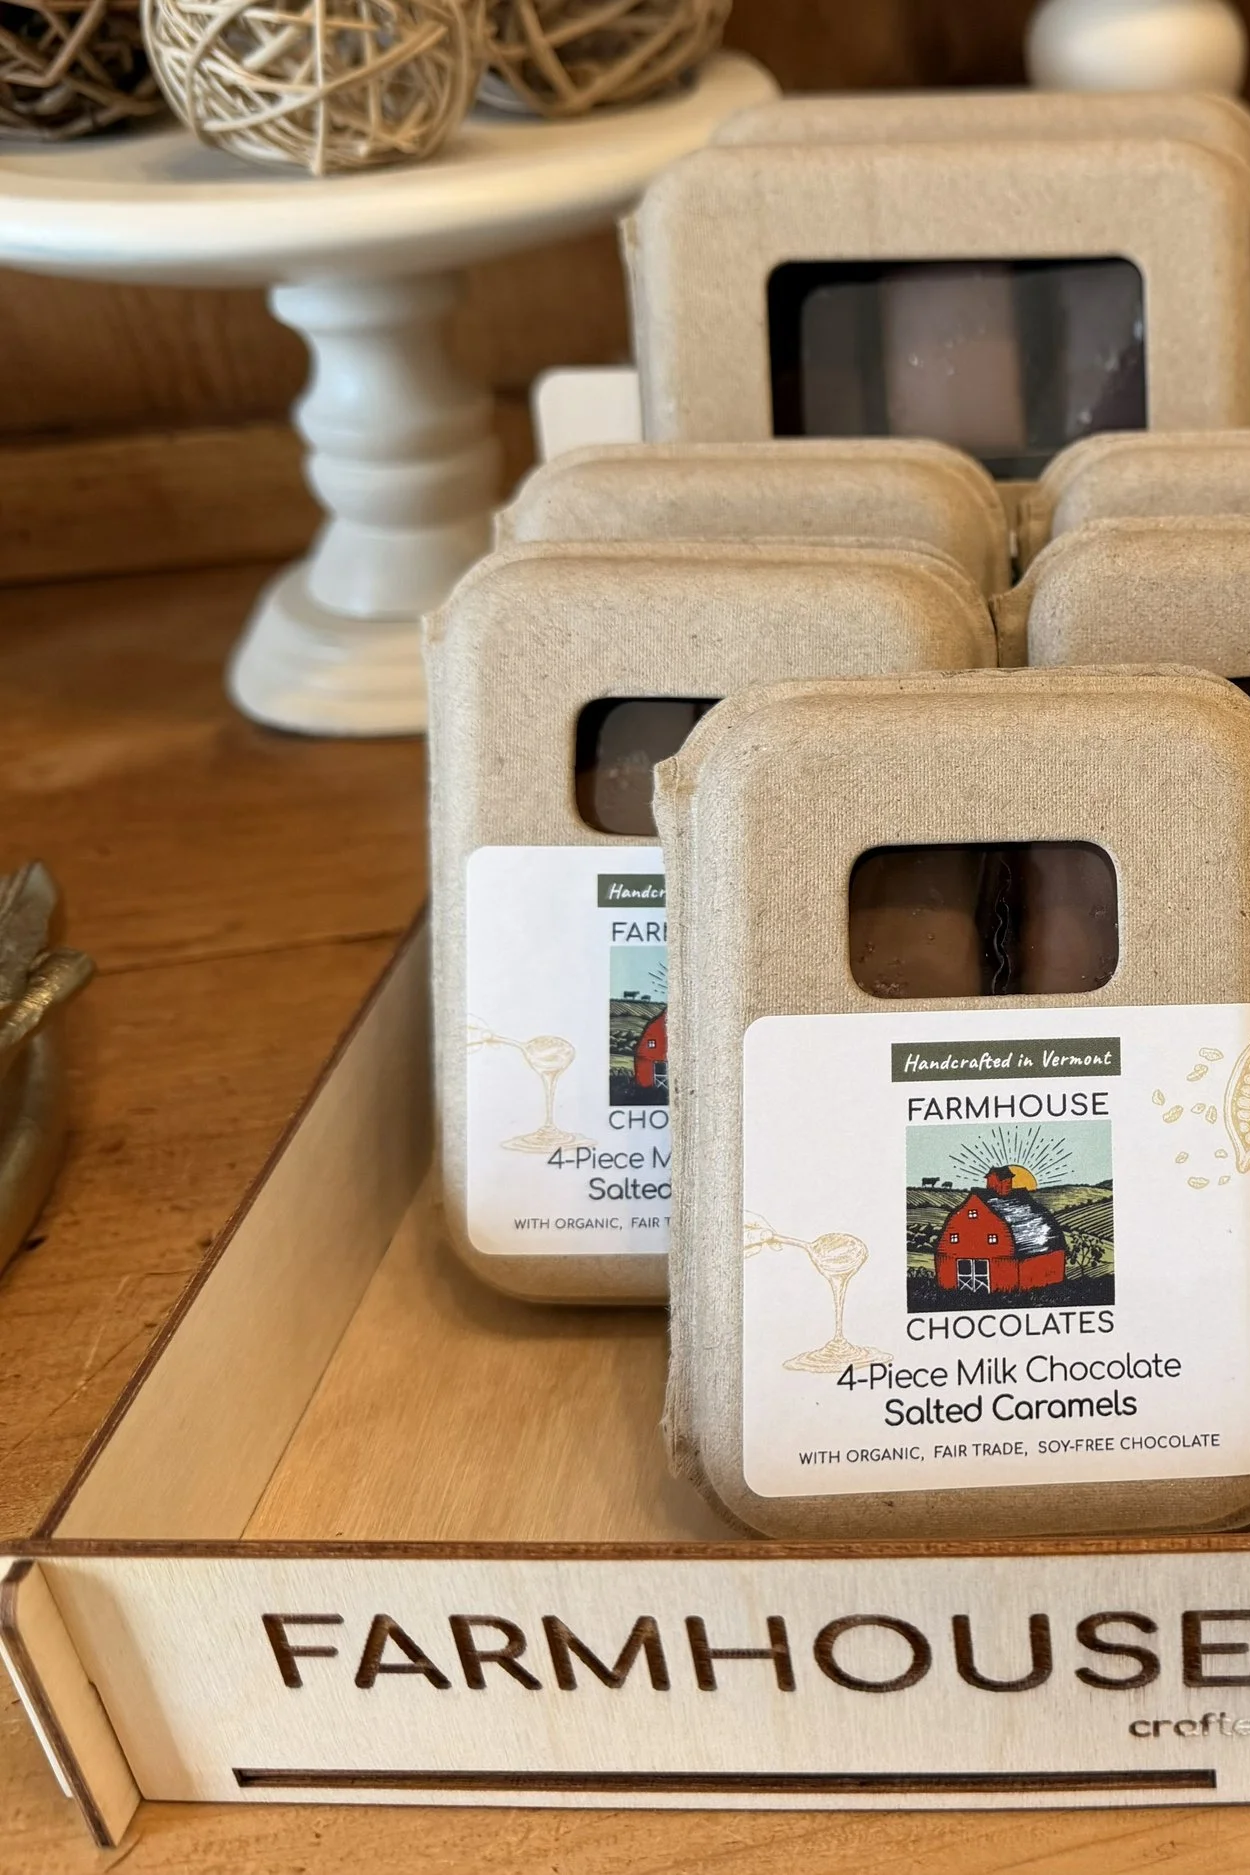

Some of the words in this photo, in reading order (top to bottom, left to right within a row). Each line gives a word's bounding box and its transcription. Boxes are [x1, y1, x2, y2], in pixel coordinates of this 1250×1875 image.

[608, 882, 666, 900] Handcr
[904, 1051, 1013, 1073] Handcrafted
[1018, 1053, 1033, 1068] in
[1042, 1050, 1112, 1068] Vermont
[908, 1092, 1109, 1121] FARMHOUSE
[547, 1146, 644, 1169] 4-Piece
[514, 1218, 550, 1230] WITH
[555, 1218, 623, 1231] ORGANIC,
[632, 1217, 660, 1229] FAIR
[906, 1310, 1115, 1341] CHOCOLATES
[837, 1363, 948, 1391] 4-Piece
[957, 1357, 1017, 1386] Milk
[1026, 1352, 1182, 1383] Chocolate
[884, 1395, 983, 1427] Salted
[992, 1389, 1138, 1422] Caramels
[799, 1449, 840, 1466] WITH
[846, 1446, 925, 1463] ORGANIC,
[934, 1443, 968, 1459] FAIR
[972, 1441, 1029, 1457] TRADE,
[1038, 1437, 1115, 1455] SOY-FREE
[1119, 1433, 1220, 1452] CHOCOLATE
